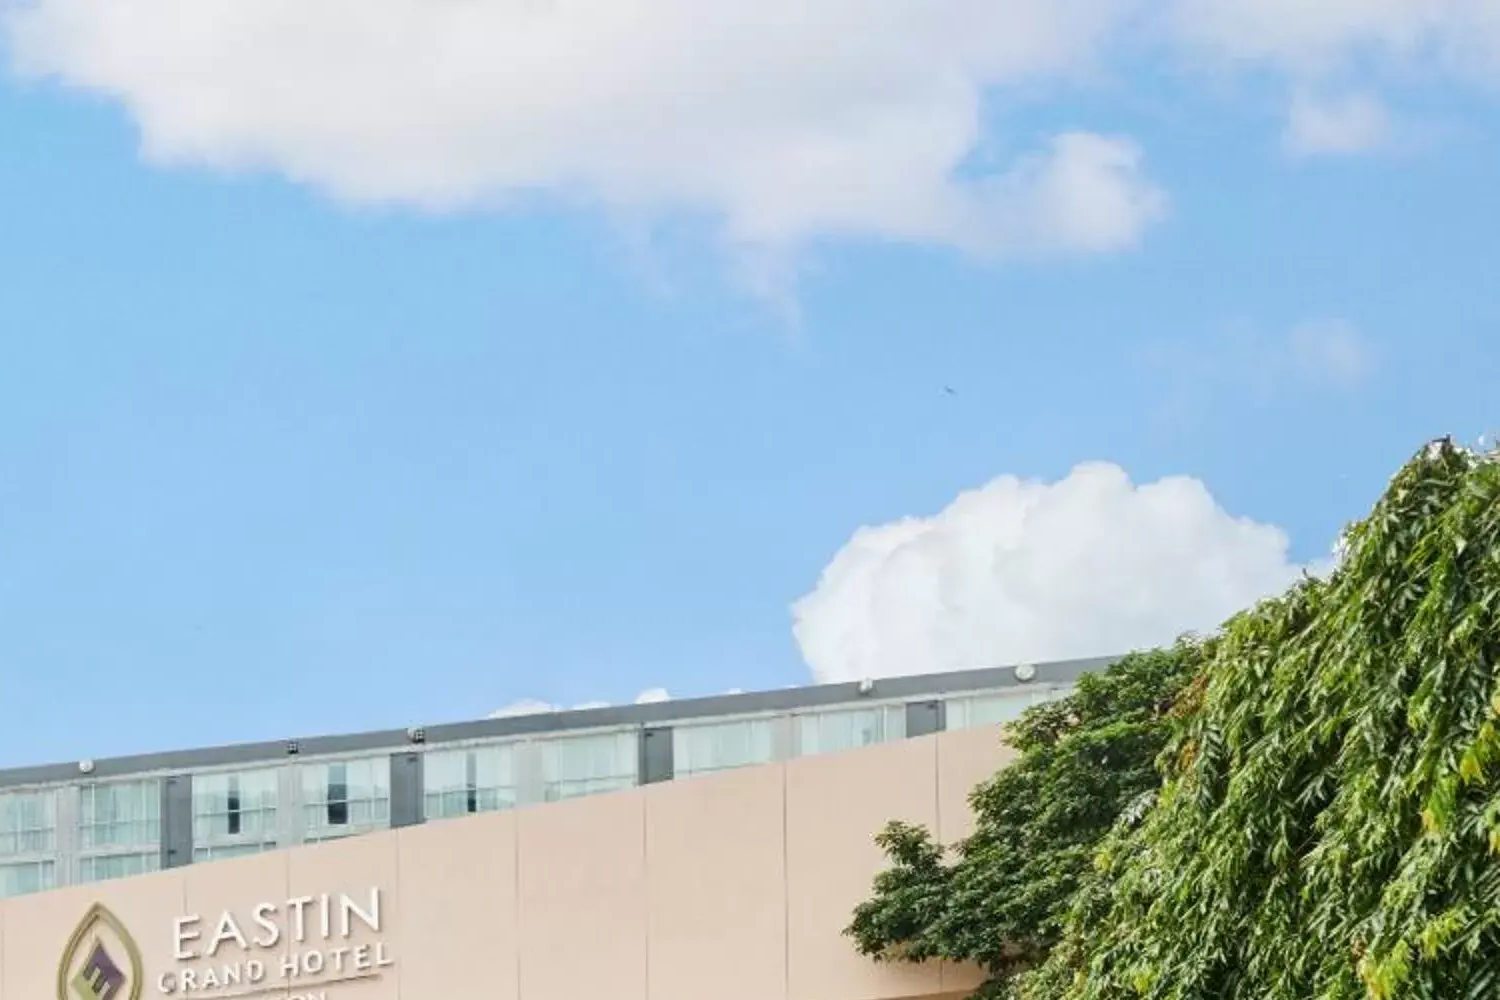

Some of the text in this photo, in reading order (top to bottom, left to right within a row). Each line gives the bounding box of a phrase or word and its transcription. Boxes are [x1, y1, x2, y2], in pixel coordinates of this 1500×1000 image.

[174, 886, 383, 960] EASTIN
[157, 943, 393, 995] GRAND HOTEL
